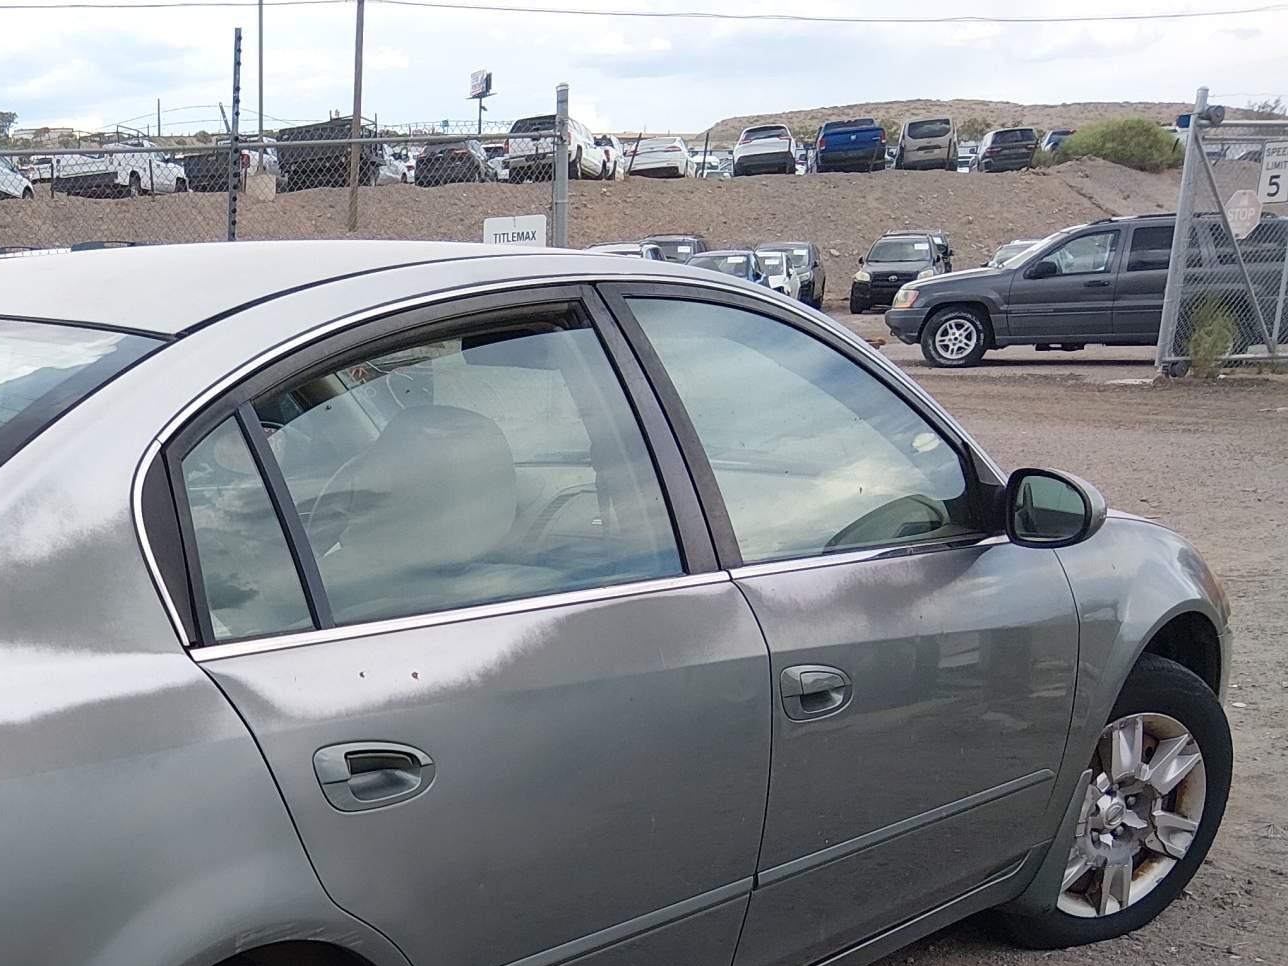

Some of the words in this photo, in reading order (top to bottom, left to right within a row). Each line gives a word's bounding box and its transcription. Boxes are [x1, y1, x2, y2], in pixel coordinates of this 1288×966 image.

[1265, 147, 1288, 157] SPEE
[1266, 174, 1281, 198] 5
[1227, 207, 1256, 221] STOP
[493, 230, 537, 244] TITLEMAX
